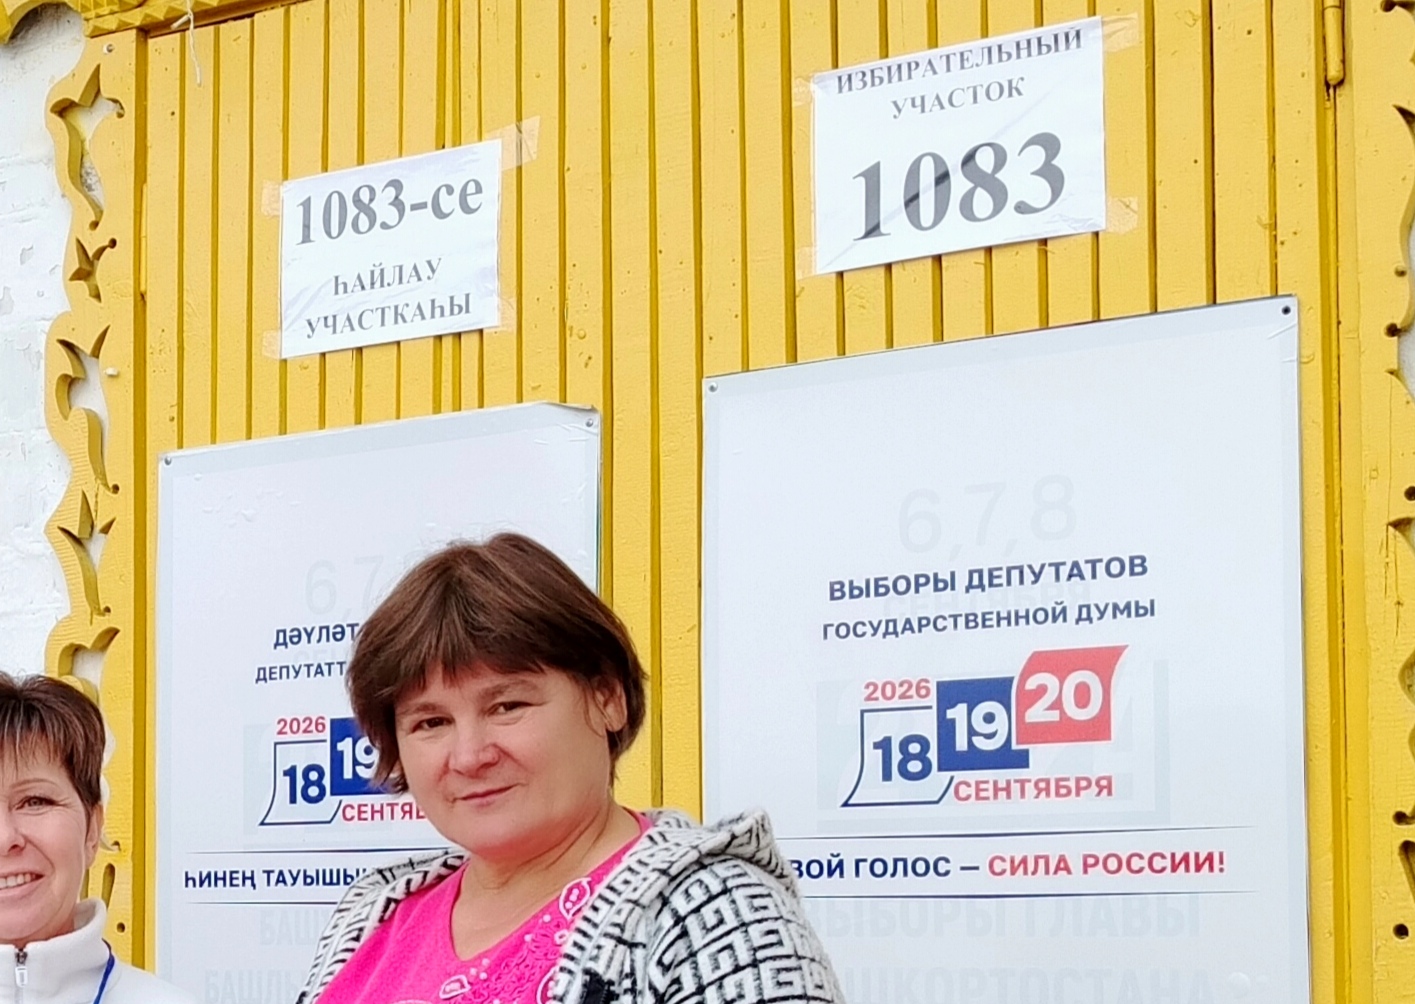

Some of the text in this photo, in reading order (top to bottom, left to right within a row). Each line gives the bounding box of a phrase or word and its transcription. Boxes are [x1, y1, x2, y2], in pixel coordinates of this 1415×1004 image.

[837, 27, 1083, 94] ИЗБИРАТЕЛЬНЫЙ
[891, 76, 1024, 119] УЧАСТОК
[852, 131, 1066, 242] 1083
[295, 178, 483, 246] 1083-се
[829, 554, 1149, 601] ВЫБОРЫ ДЕПУТАТОВ
[823, 598, 1156, 640] ГОСУДАРСТВЕННОЙ ДУМЫ
[863, 678, 931, 702] 2026
[276, 716, 326, 736] 2026
[872, 669, 1103, 783] 18 19 20
[282, 736, 381, 805] 18 19
[953, 775, 1114, 802] СЕНТЯБРЯ
[853, 856, 951, 879] ГОЛОС
[988, 853, 1072, 877] СИЛА
[1082, 851, 1226, 876] РОССИИ!
